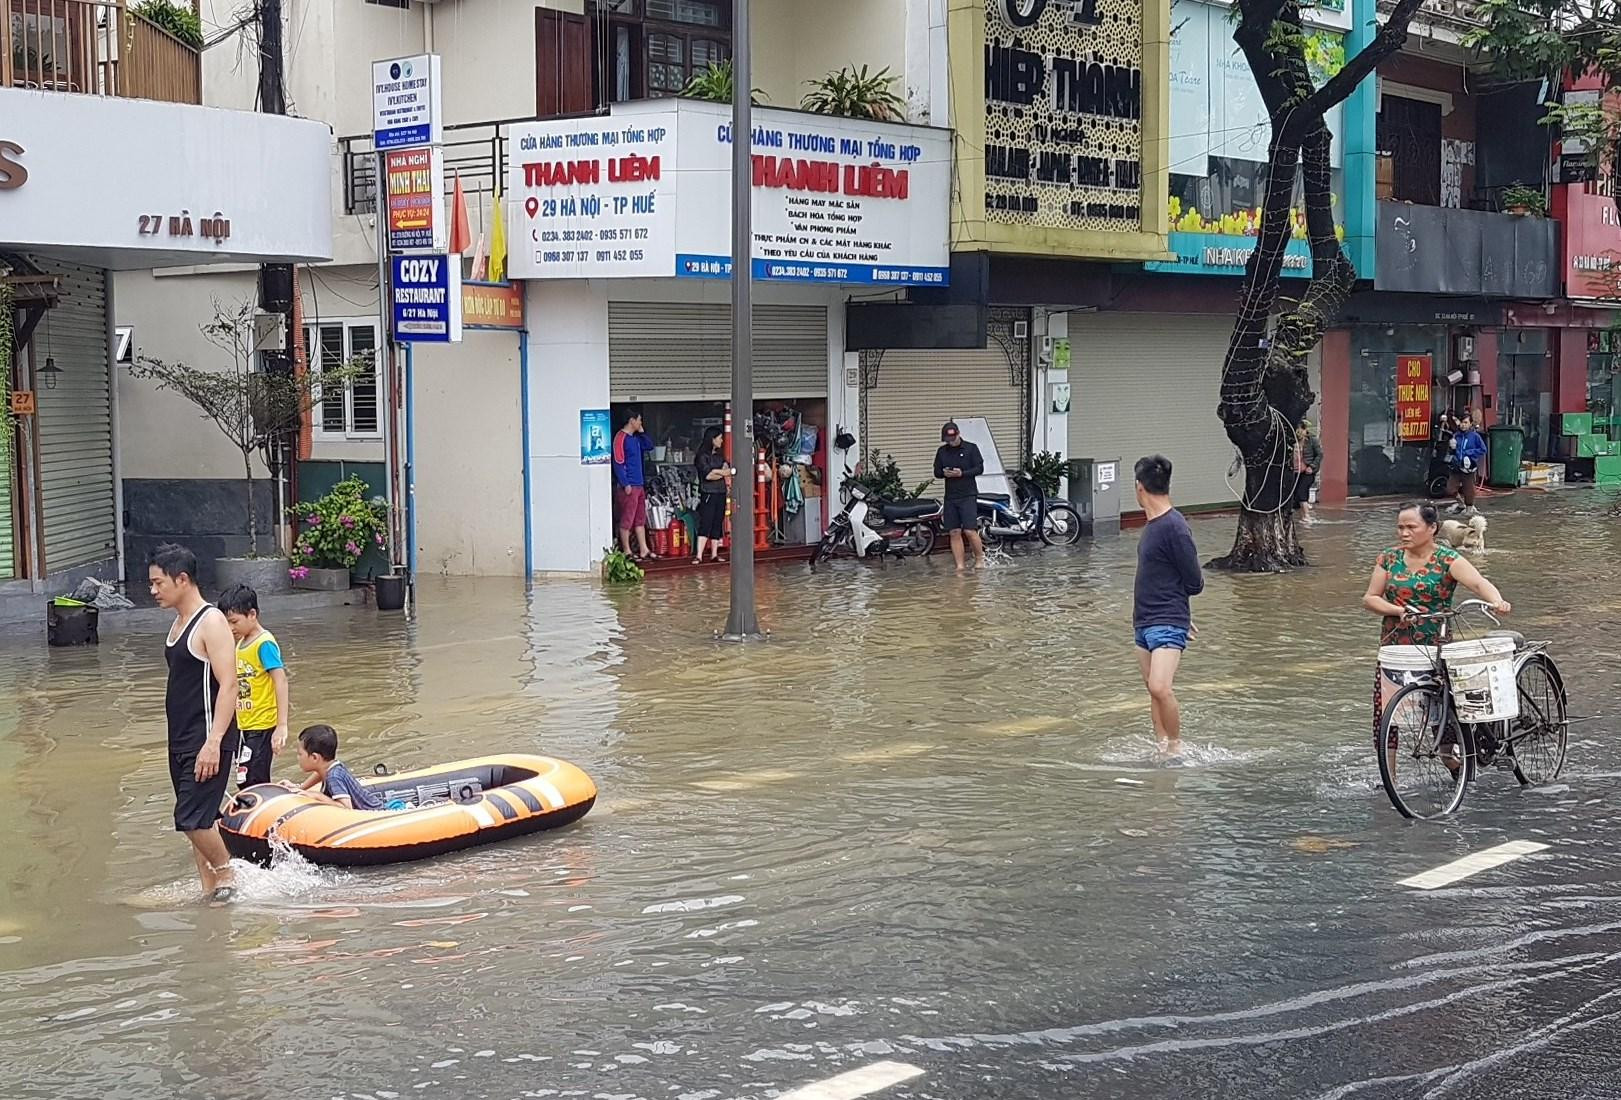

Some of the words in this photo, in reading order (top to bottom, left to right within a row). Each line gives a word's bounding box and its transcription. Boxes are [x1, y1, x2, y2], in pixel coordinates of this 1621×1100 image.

[520, 134, 537, 150] CỬA
[540, 134, 562, 149] HÀNG
[566, 132, 598, 147] THƯƠNG
[602, 131, 619, 149] MẠI
[622, 124, 644, 143] TỔNG
[647, 130, 666, 144] HỢP
[718, 121, 734, 143] CỬ
[788, 132, 835, 153] THƯƠNG
[840, 138, 862, 158] MẠI
[867, 136, 895, 159] TỔNG
[899, 145, 920, 164] HỢP
[390, 153, 406, 168] NHÀ
[522, 159, 600, 187] THANH
[608, 153, 660, 182] LIÊM
[390, 171, 410, 194] MINH
[751, 154, 839, 193] HANH
[844, 162, 908, 200] LIÊM
[542, 199, 556, 217] 29
[560, 195, 576, 216] HÀ
[580, 194, 600, 218] NỘI
[613, 196, 628, 214] TP
[632, 189, 656, 214] HUẾ
[139, 215, 163, 235] 27
[169, 210, 193, 236] HÀ
[200, 212, 230, 246] NỘI
[600, 230, 617, 241] 0935
[619, 229, 632, 240] 571
[635, 228, 648, 239] 672
[562, 251, 574, 262] 307
[577, 251, 588, 262] 137
[596, 250, 611, 261] 0911
[613, 250, 627, 261] 452
[630, 250, 643, 260] 055
[692, 262, 699, 272] 29
[400, 260, 439, 282] COZY
[395, 288, 445, 304] RESTAURANT
[417, 308, 425, 318] Hà
[1408, 360, 1420, 377] CHO
[16, 394, 29, 404] 27
[1398, 382, 1414, 402] THUÊ
[1415, 380, 1429, 401] NHÀ
